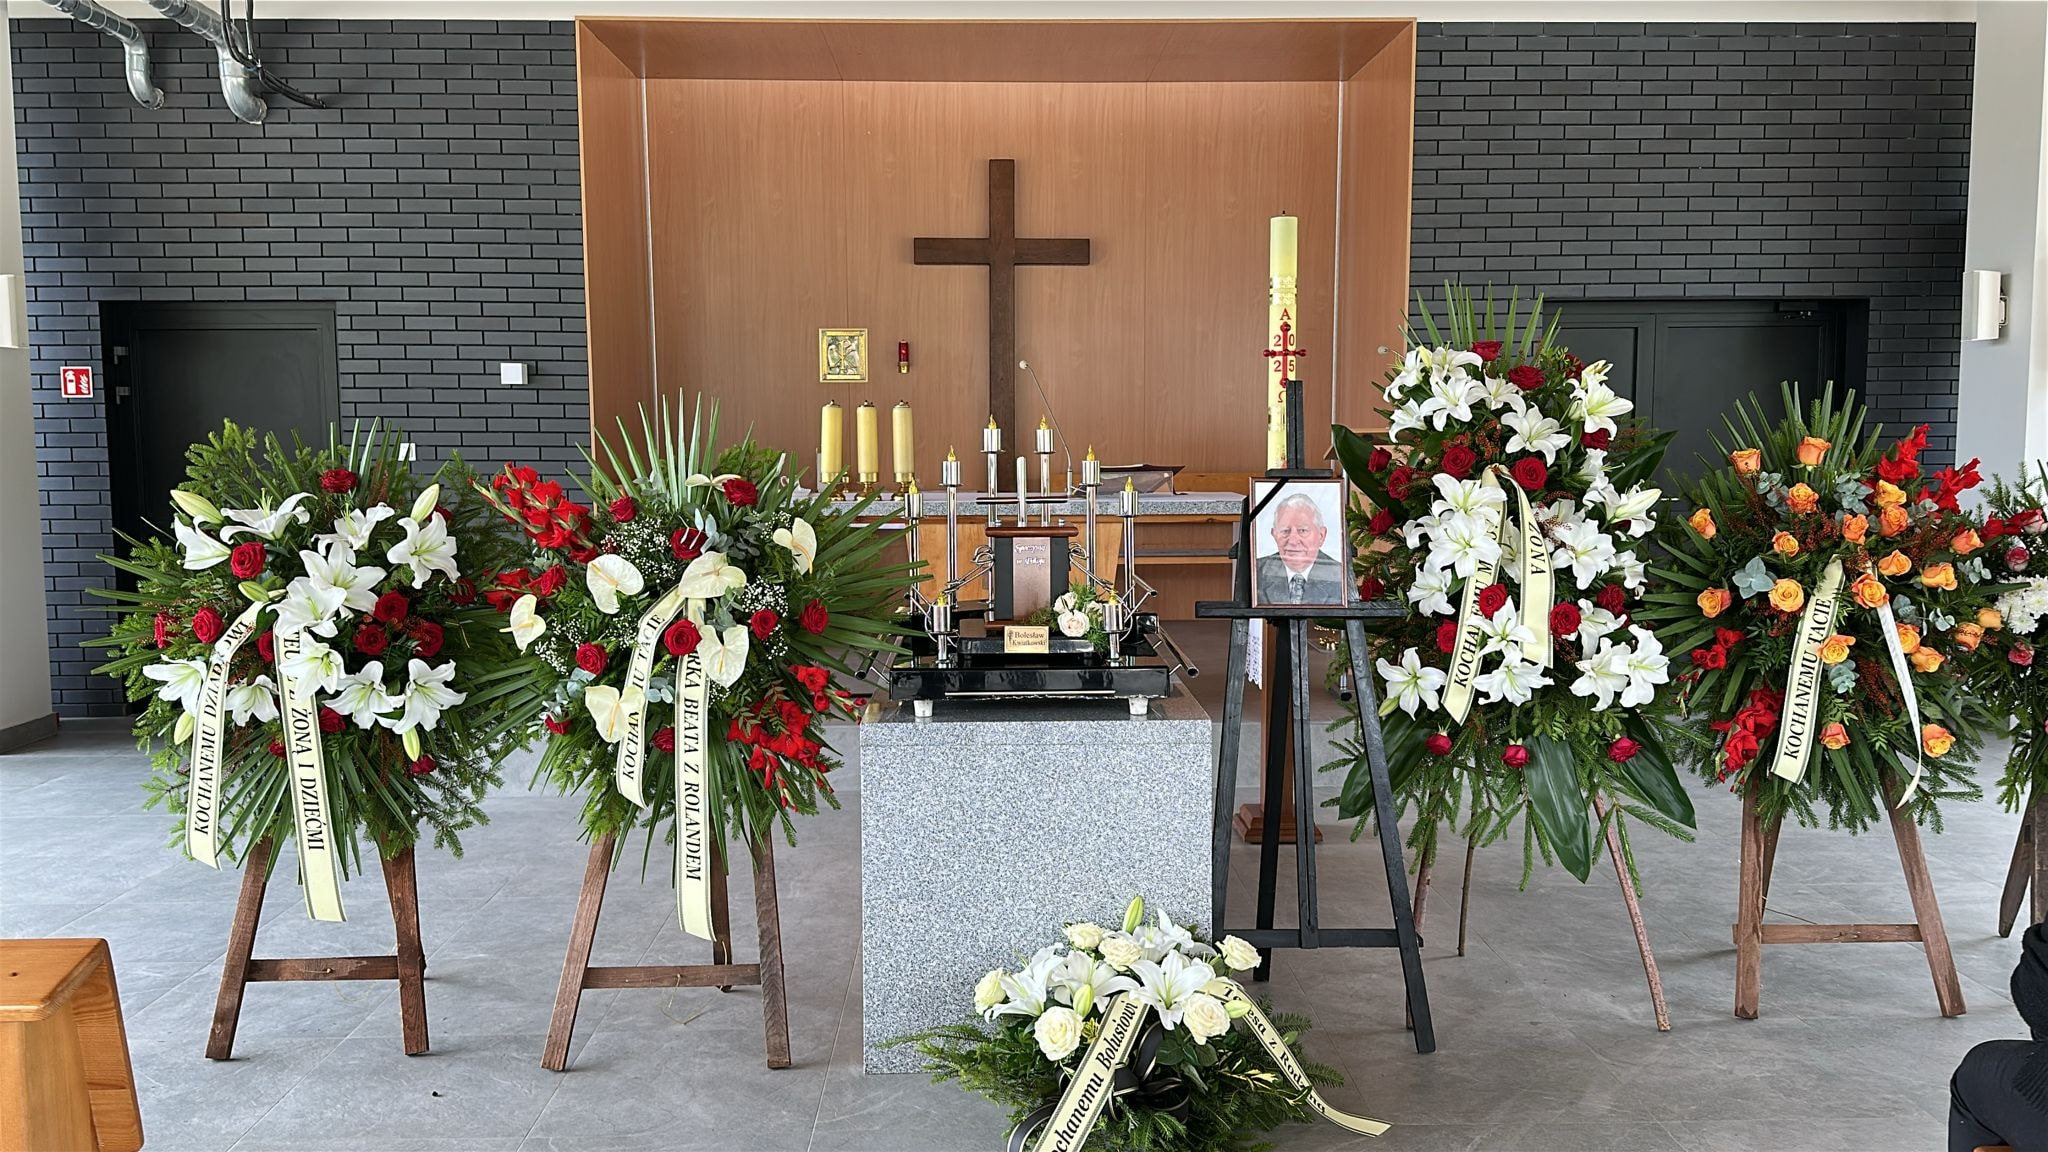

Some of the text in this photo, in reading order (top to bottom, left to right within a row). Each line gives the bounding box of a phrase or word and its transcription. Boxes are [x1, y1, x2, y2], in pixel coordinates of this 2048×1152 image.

[1280, 308, 1291, 320] A
[622, 614, 665, 780] KOCHANU TACIE
[1784, 597, 1832, 760] KOCHANEMU TACIE
[292, 707, 313, 756] ŻONĄ
[683, 697, 700, 755] BEATA
[194, 722, 217, 835] KOCHANEMU
[683, 763, 700, 774] Z
[300, 777, 325, 851] DZIEĆMI
[684, 780, 702, 882] ROLANDEM
[1095, 1000, 1139, 1072] Bolusiowi
[1268, 1037, 1278, 1050] z
